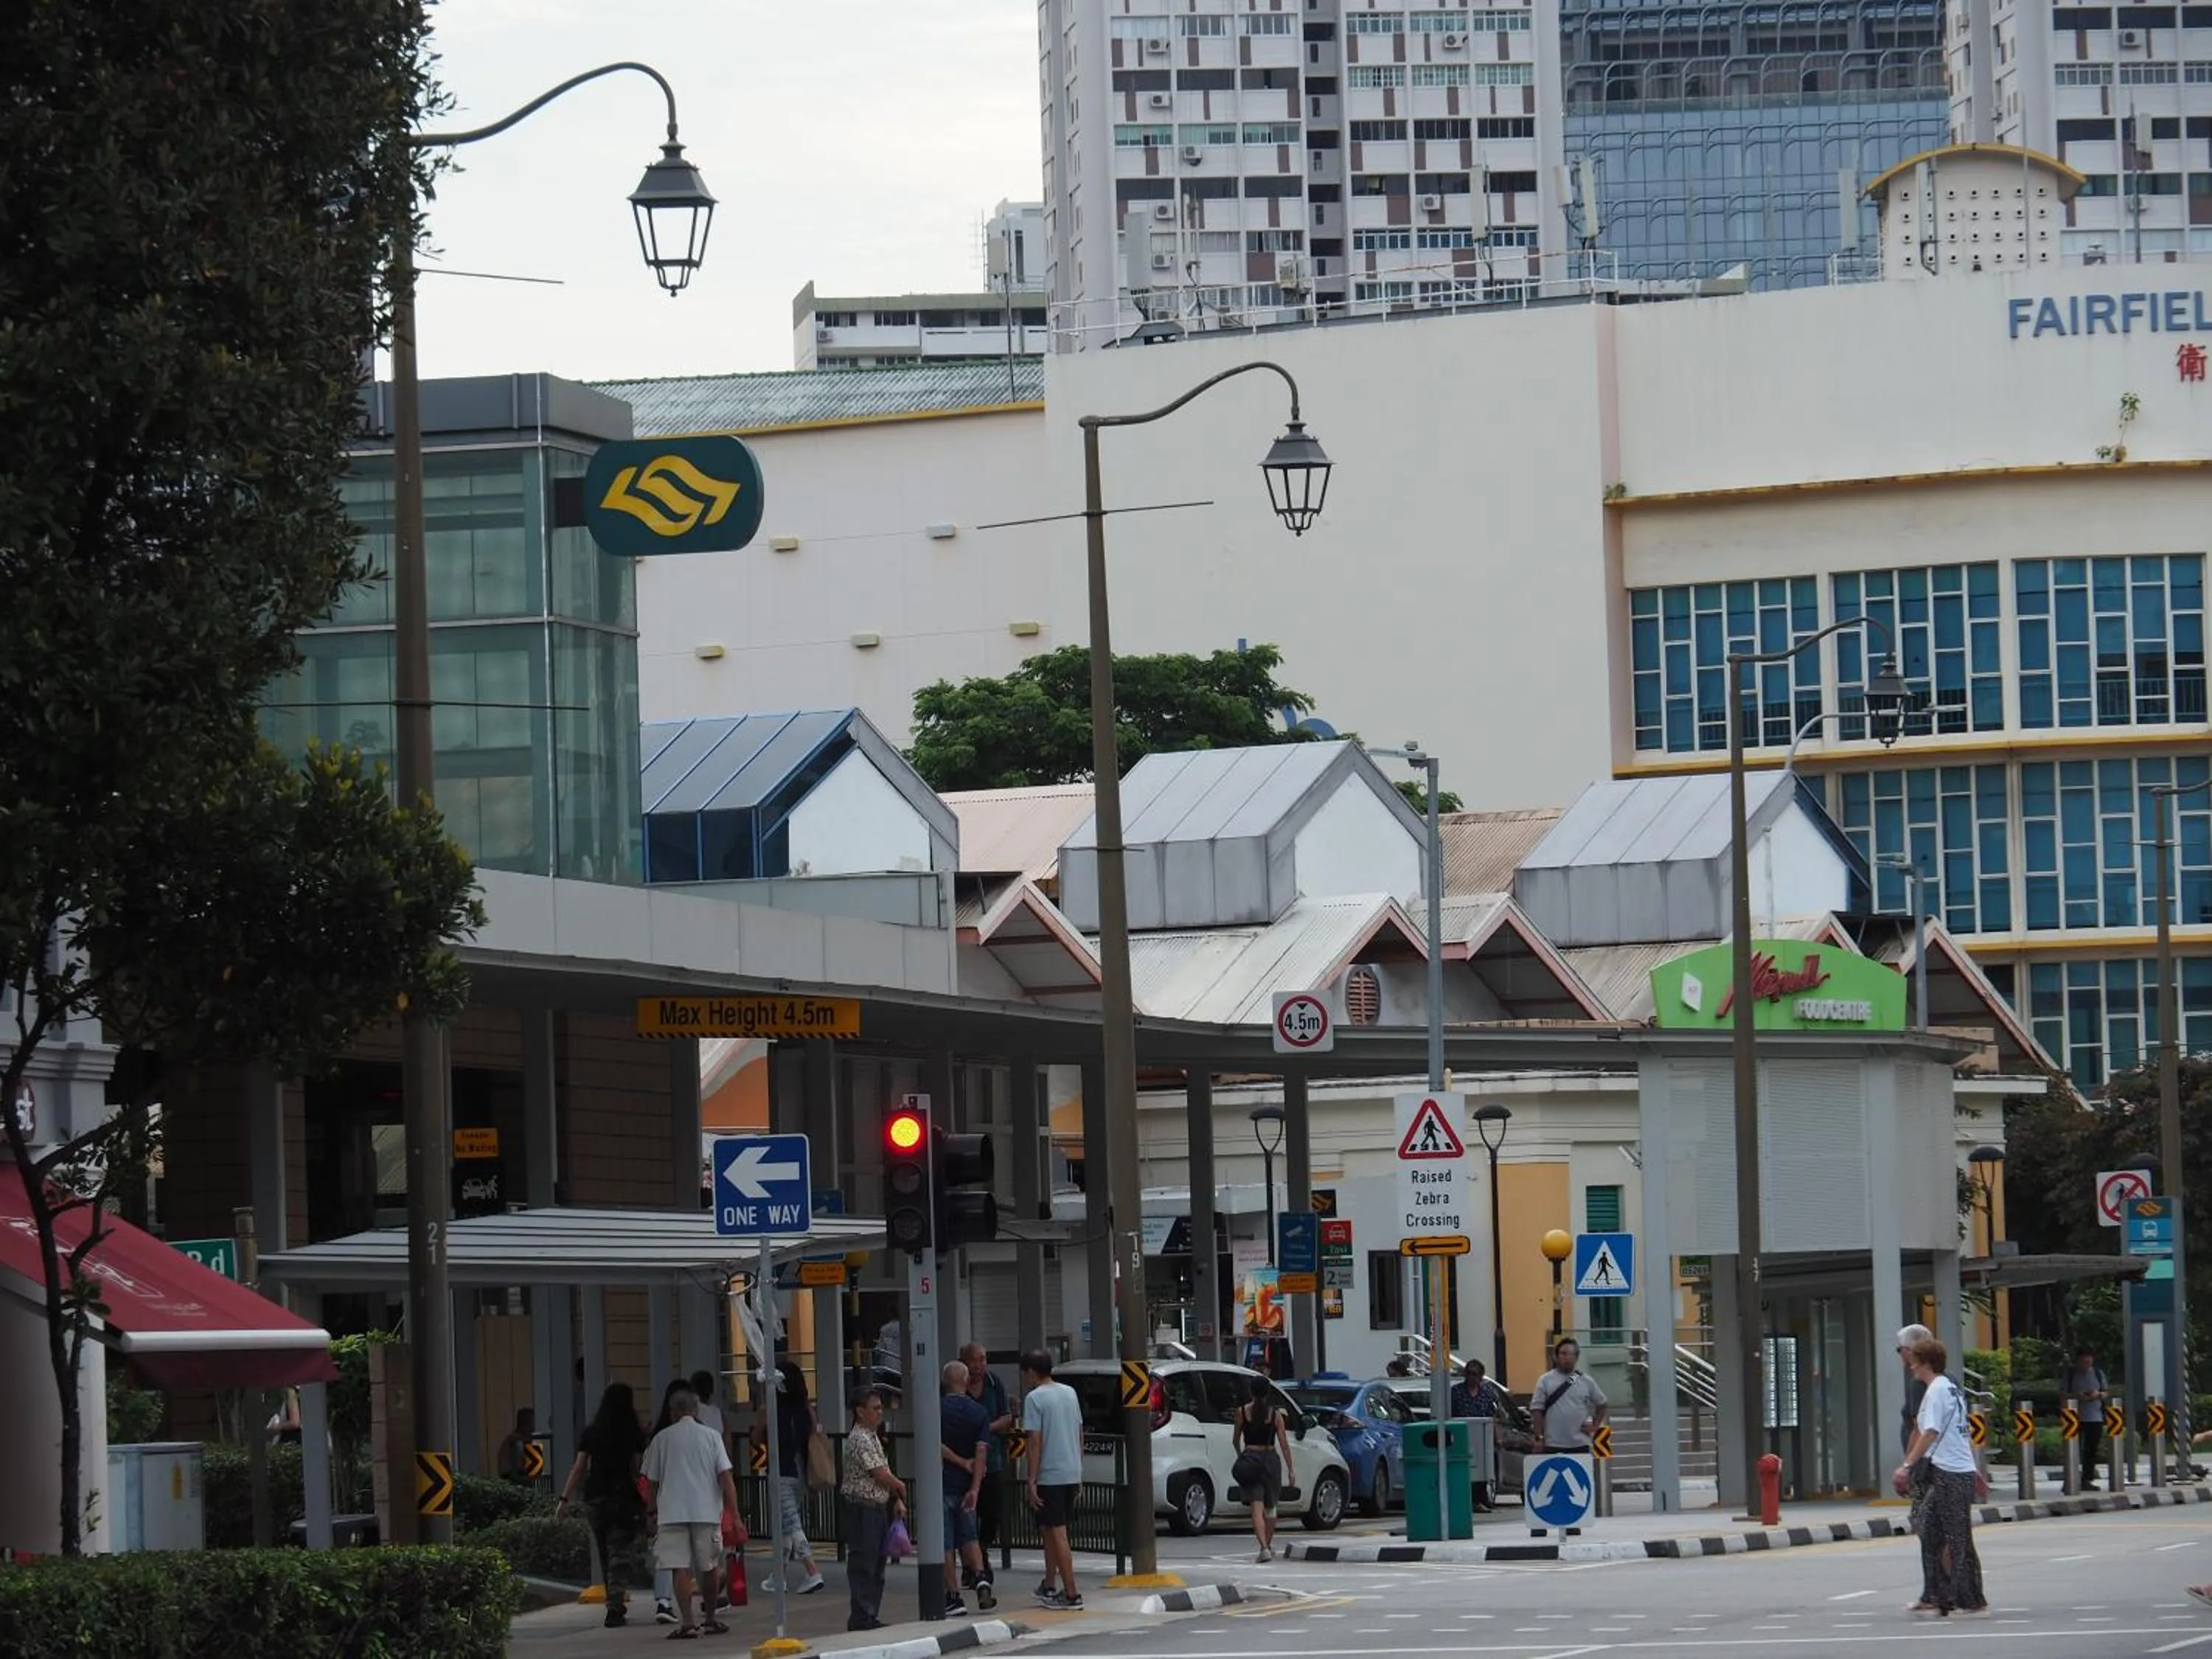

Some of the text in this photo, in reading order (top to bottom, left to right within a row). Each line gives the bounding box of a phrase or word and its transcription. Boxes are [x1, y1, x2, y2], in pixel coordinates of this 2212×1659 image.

[2008, 291, 2212, 338] FAIRFIEL
[660, 1001, 835, 1031] Max Height 4.5m
[1284, 1012, 1320, 1030] 4.5m
[1411, 1169, 1452, 1183] Raised
[1415, 1191, 1450, 1206] Zebra
[723, 1204, 801, 1225] ONE WAY
[1406, 1213, 1460, 1229] Crossing
